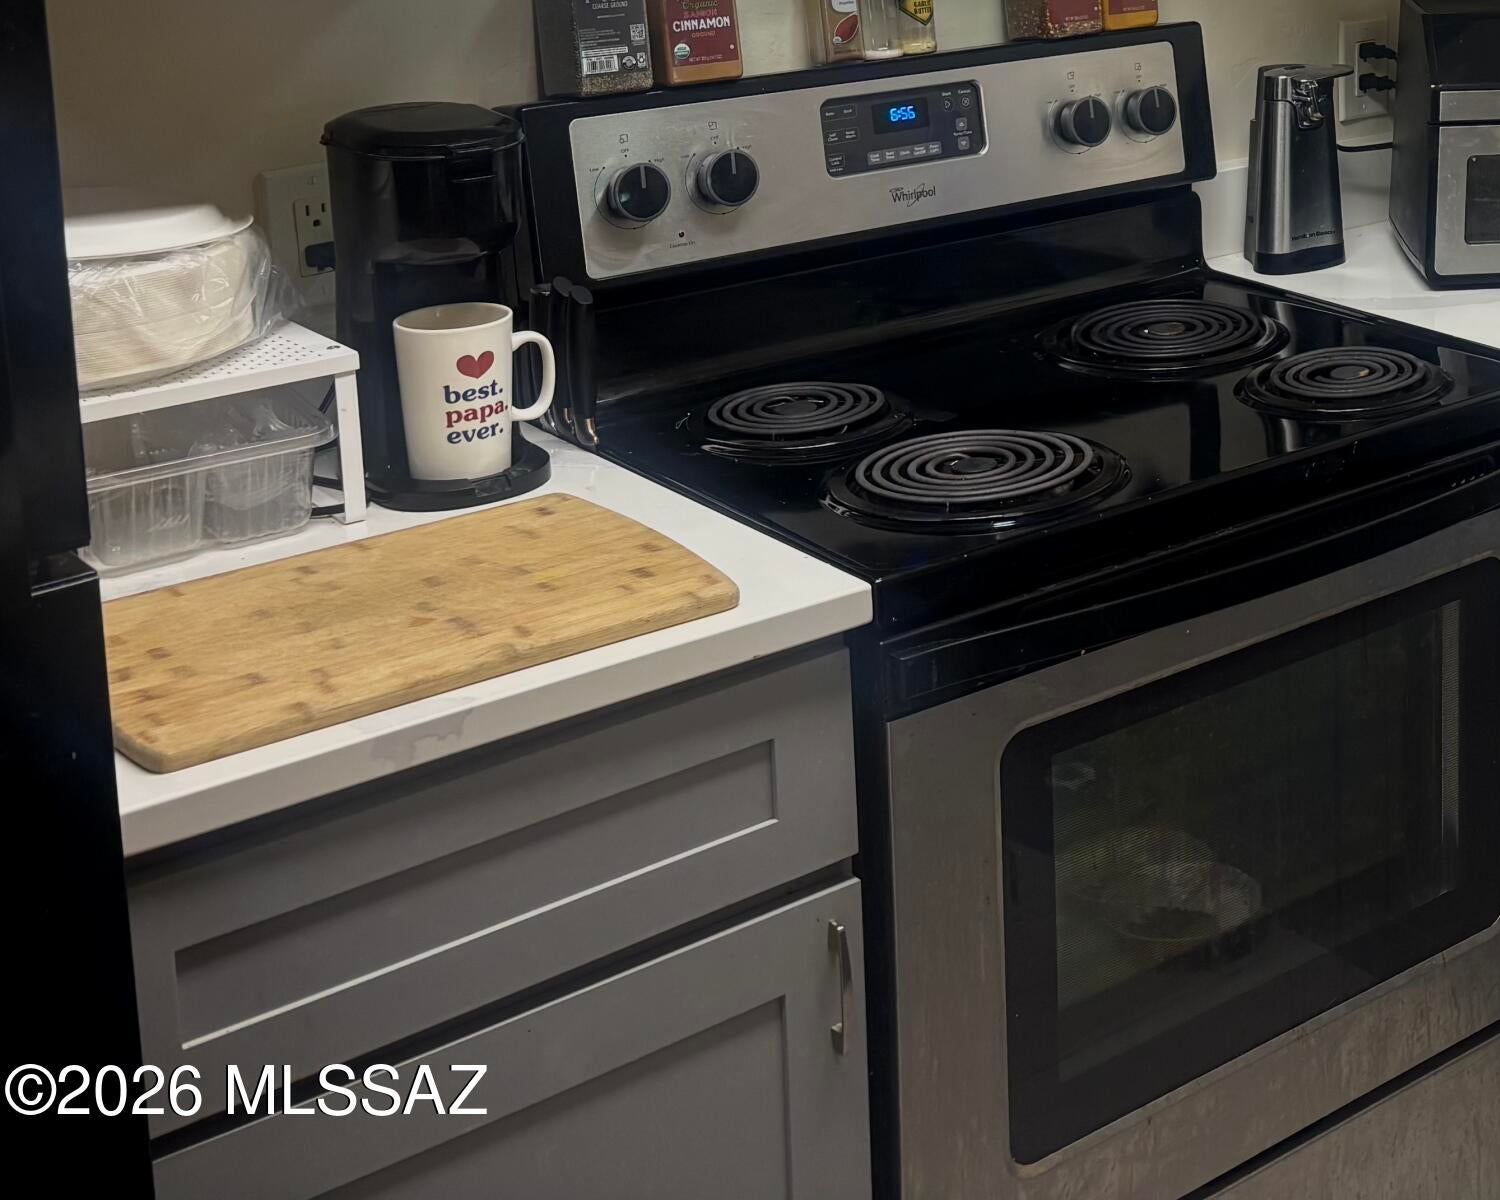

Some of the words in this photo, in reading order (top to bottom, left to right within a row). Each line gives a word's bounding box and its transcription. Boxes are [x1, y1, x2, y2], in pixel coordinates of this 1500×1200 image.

[672, 16, 731, 32] CINNAMON
[891, 185, 936, 205] Whirlpool
[442, 379, 503, 404] best.
[445, 400, 508, 428] papa.
[446, 422, 504, 445] ever.
